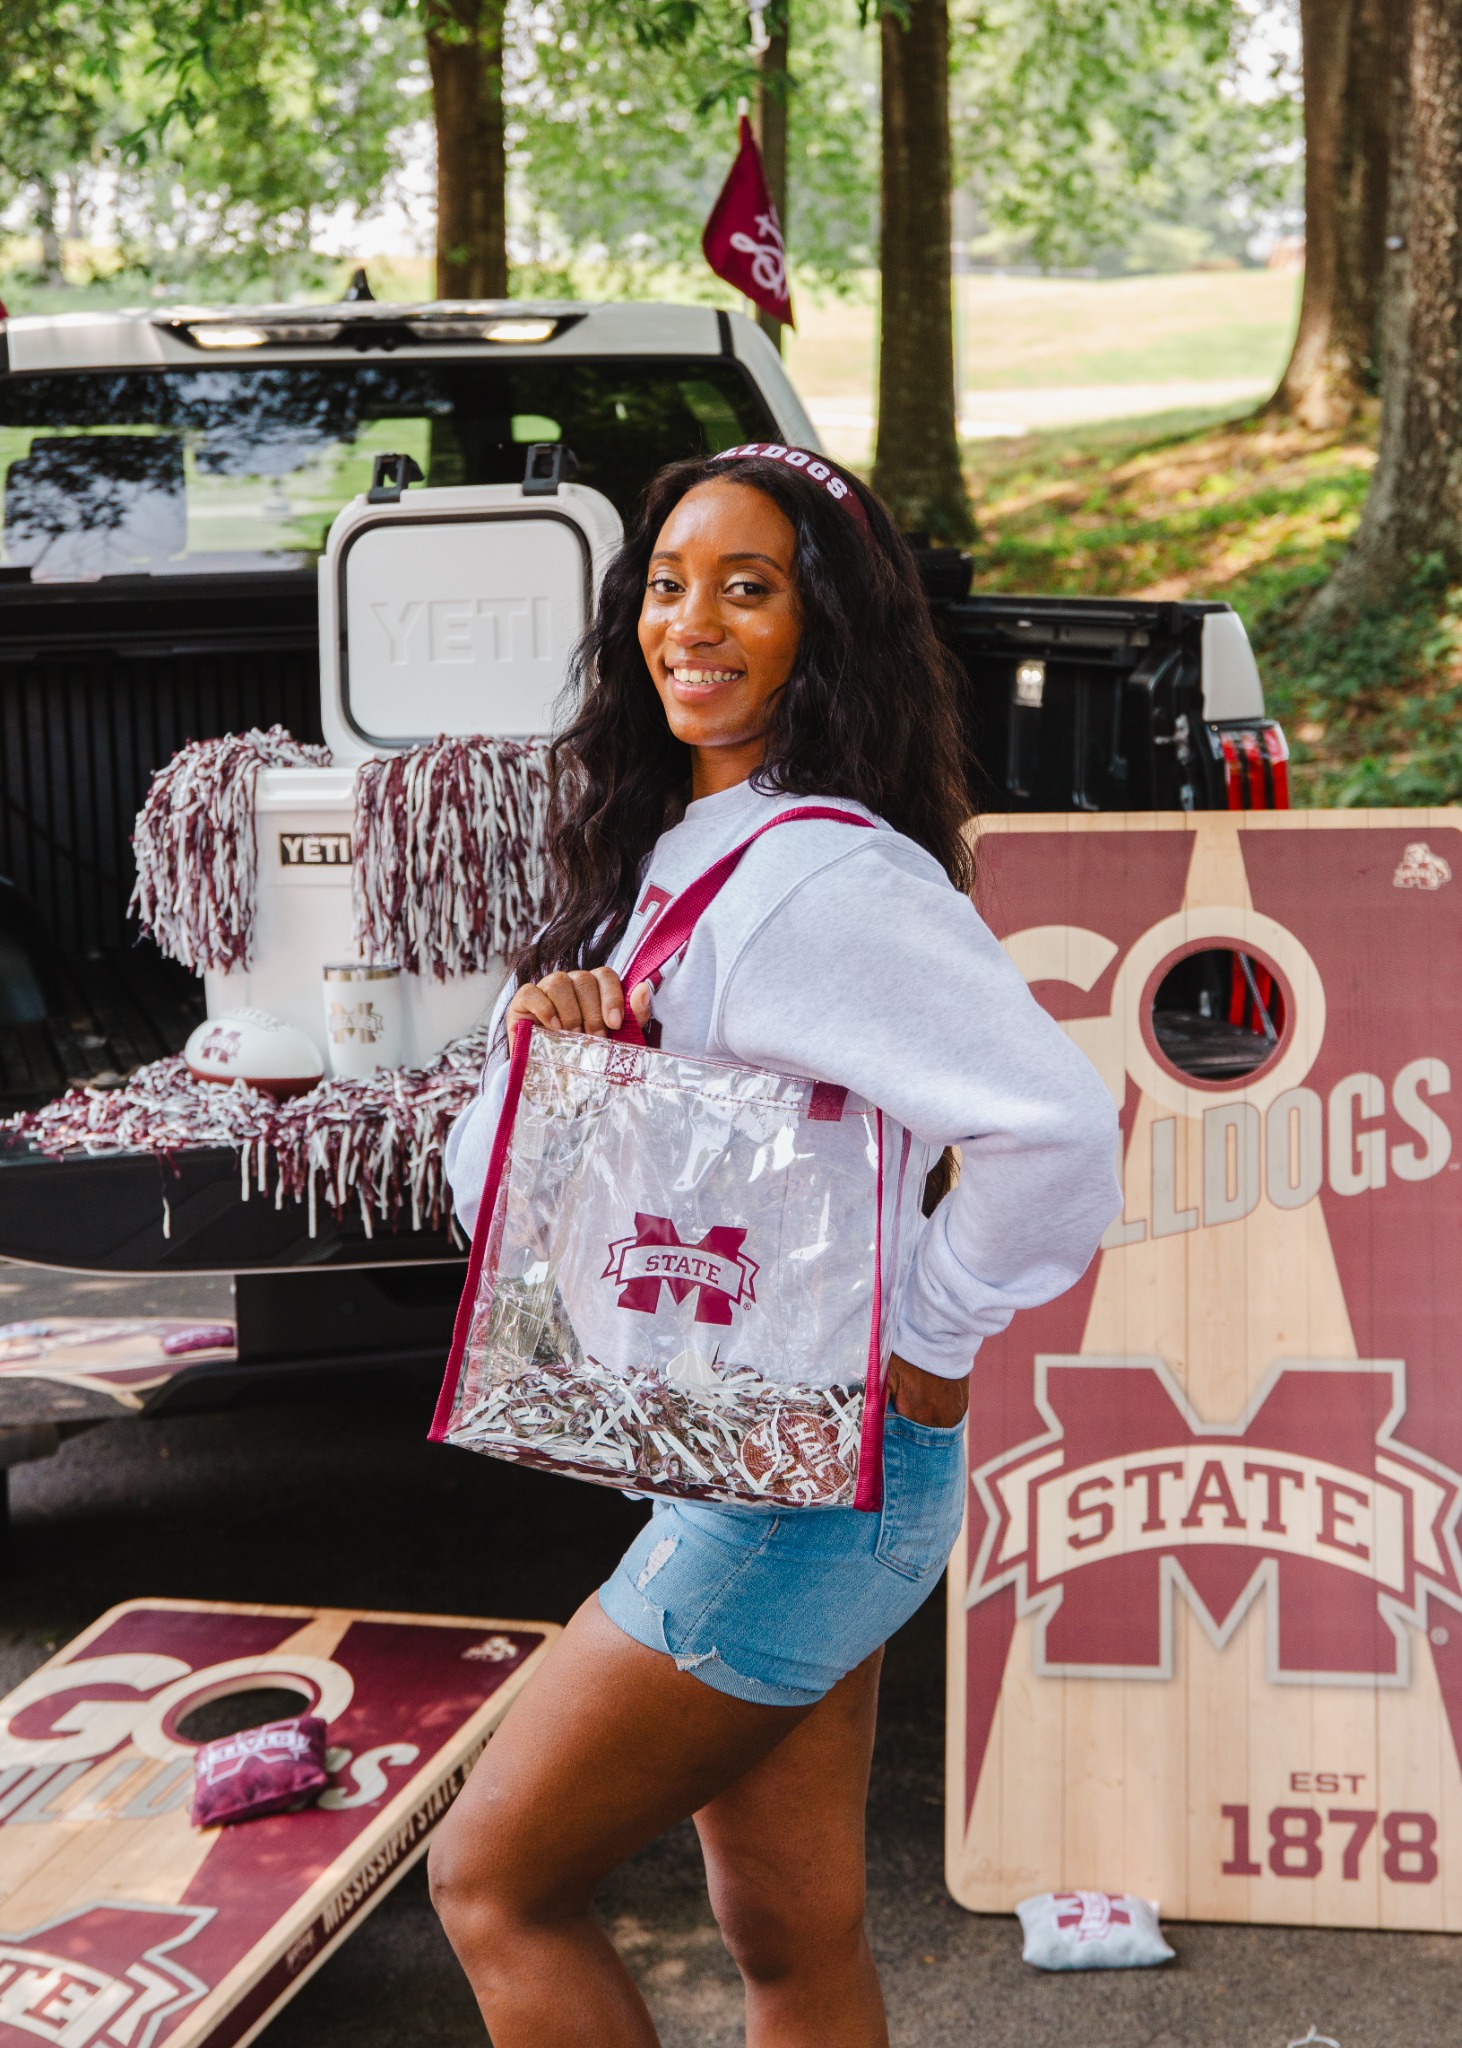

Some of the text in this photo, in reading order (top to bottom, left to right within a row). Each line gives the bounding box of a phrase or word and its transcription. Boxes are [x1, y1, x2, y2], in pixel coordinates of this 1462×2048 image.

[709, 444, 848, 500] LLDOGS
[369, 596, 551, 666] YETI
[281, 836, 350, 863] YETI
[644, 1253, 722, 1286] STATE
[787, 1422, 838, 1478] HAIL
[1066, 1459, 1371, 1562] STATE
[0, 1652, 354, 1765] GO
[1290, 1772, 1367, 1796] EST
[322, 1817, 416, 1934] MISSISSIPPI
[1220, 1803, 1439, 1885] 1878
